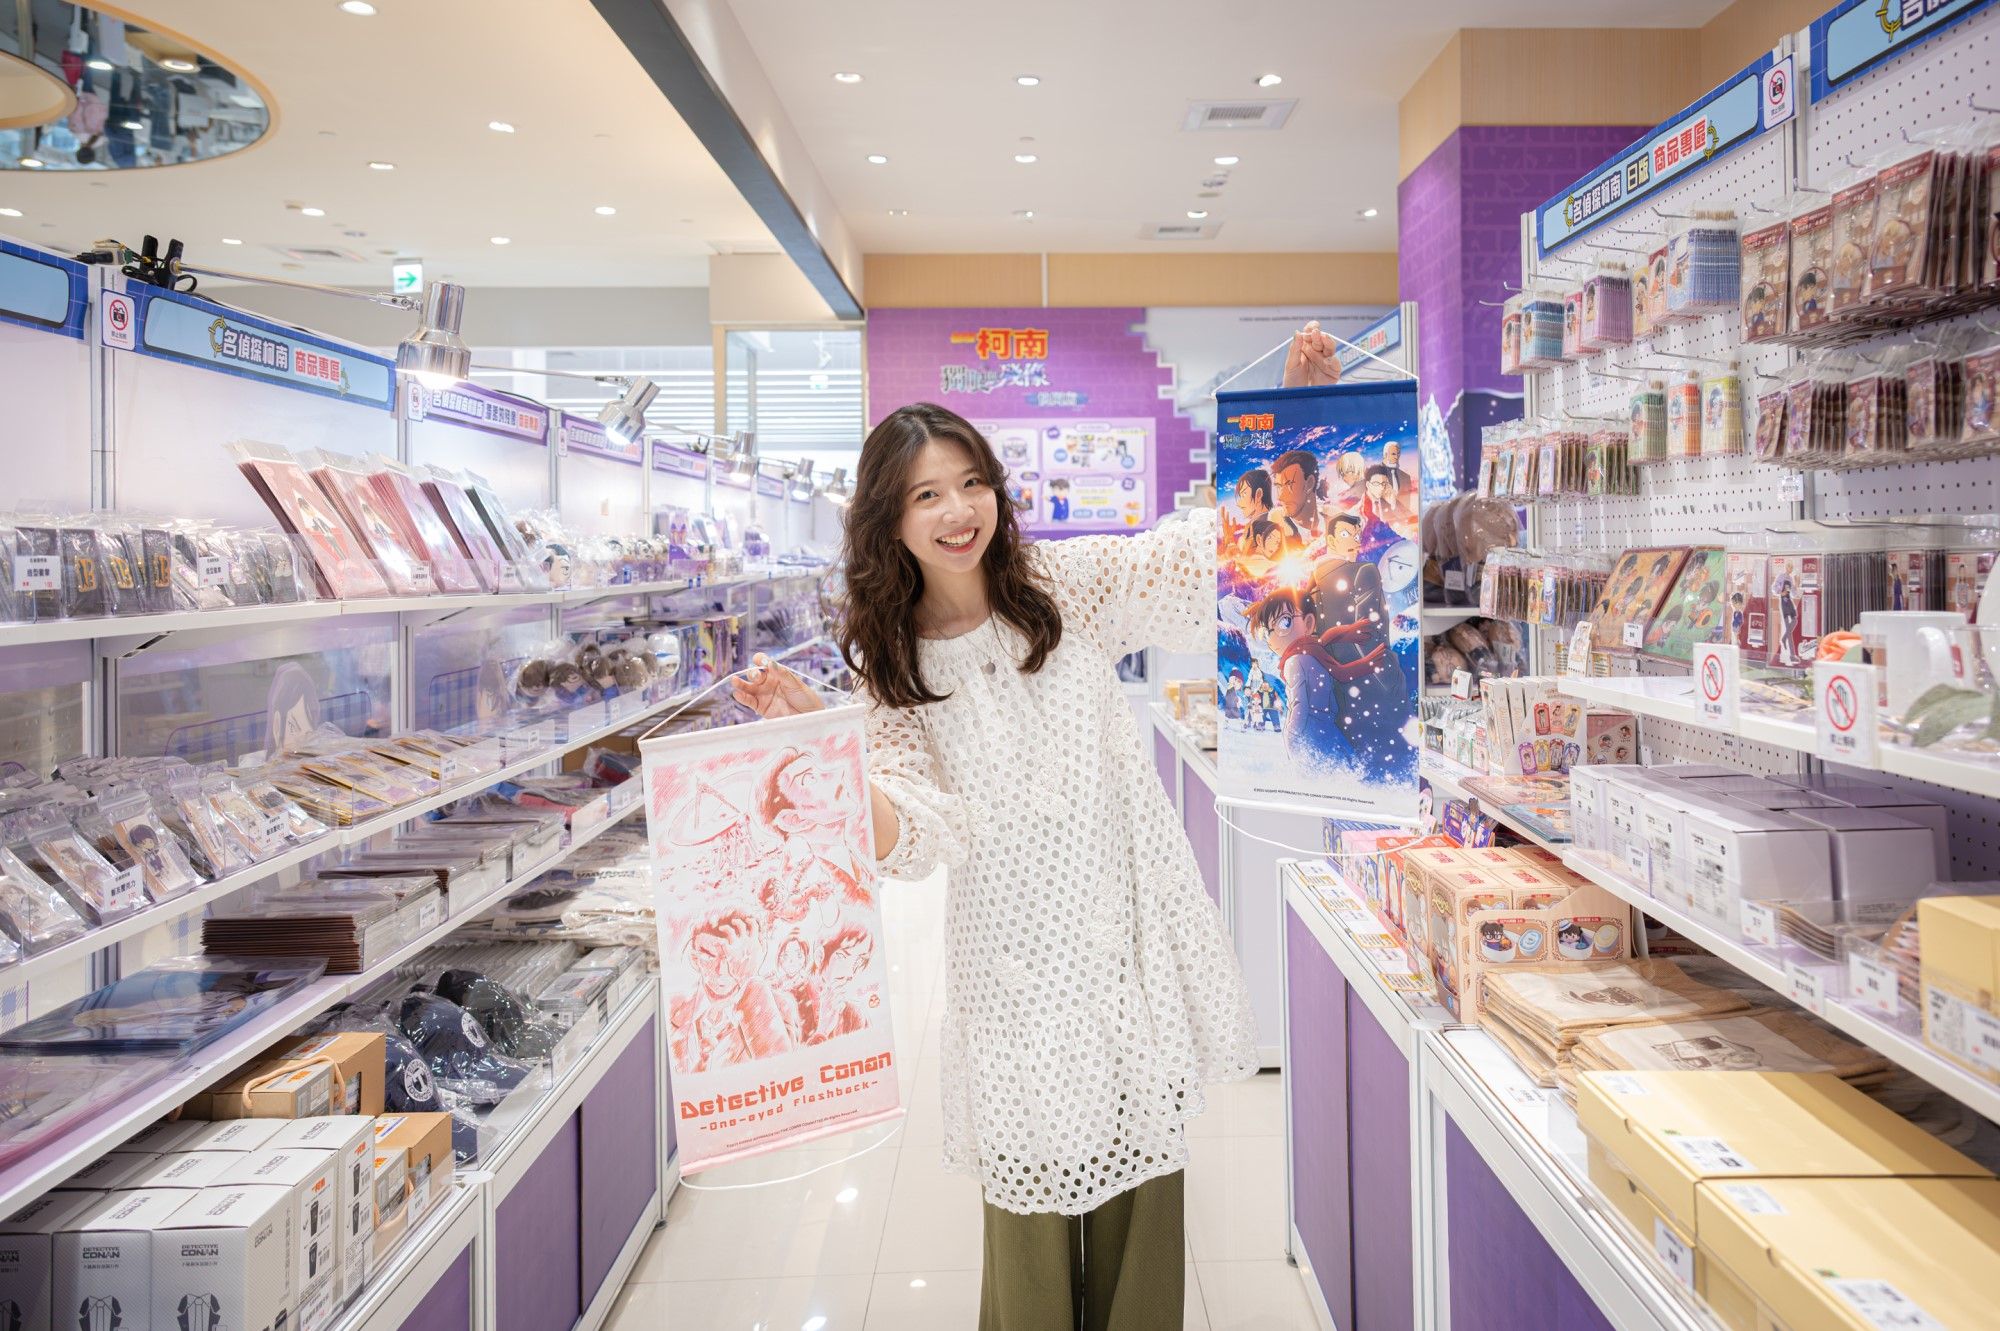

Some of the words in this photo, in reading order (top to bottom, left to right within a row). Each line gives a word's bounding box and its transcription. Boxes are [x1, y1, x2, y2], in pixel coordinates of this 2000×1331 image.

[1572, 171, 1622, 227] 名偵探柯南
[1626, 152, 1650, 193] 日版
[1653, 118, 1707, 175] 商品專區
[221, 329, 289, 371] 名偵探柯南
[294, 350, 341, 383] 商品專區
[680, 1076, 804, 1120] Detective
[819, 1051, 892, 1084] Conan
[82, 1251, 120, 1259] CONAN
[181, 1248, 219, 1257] CONAN
